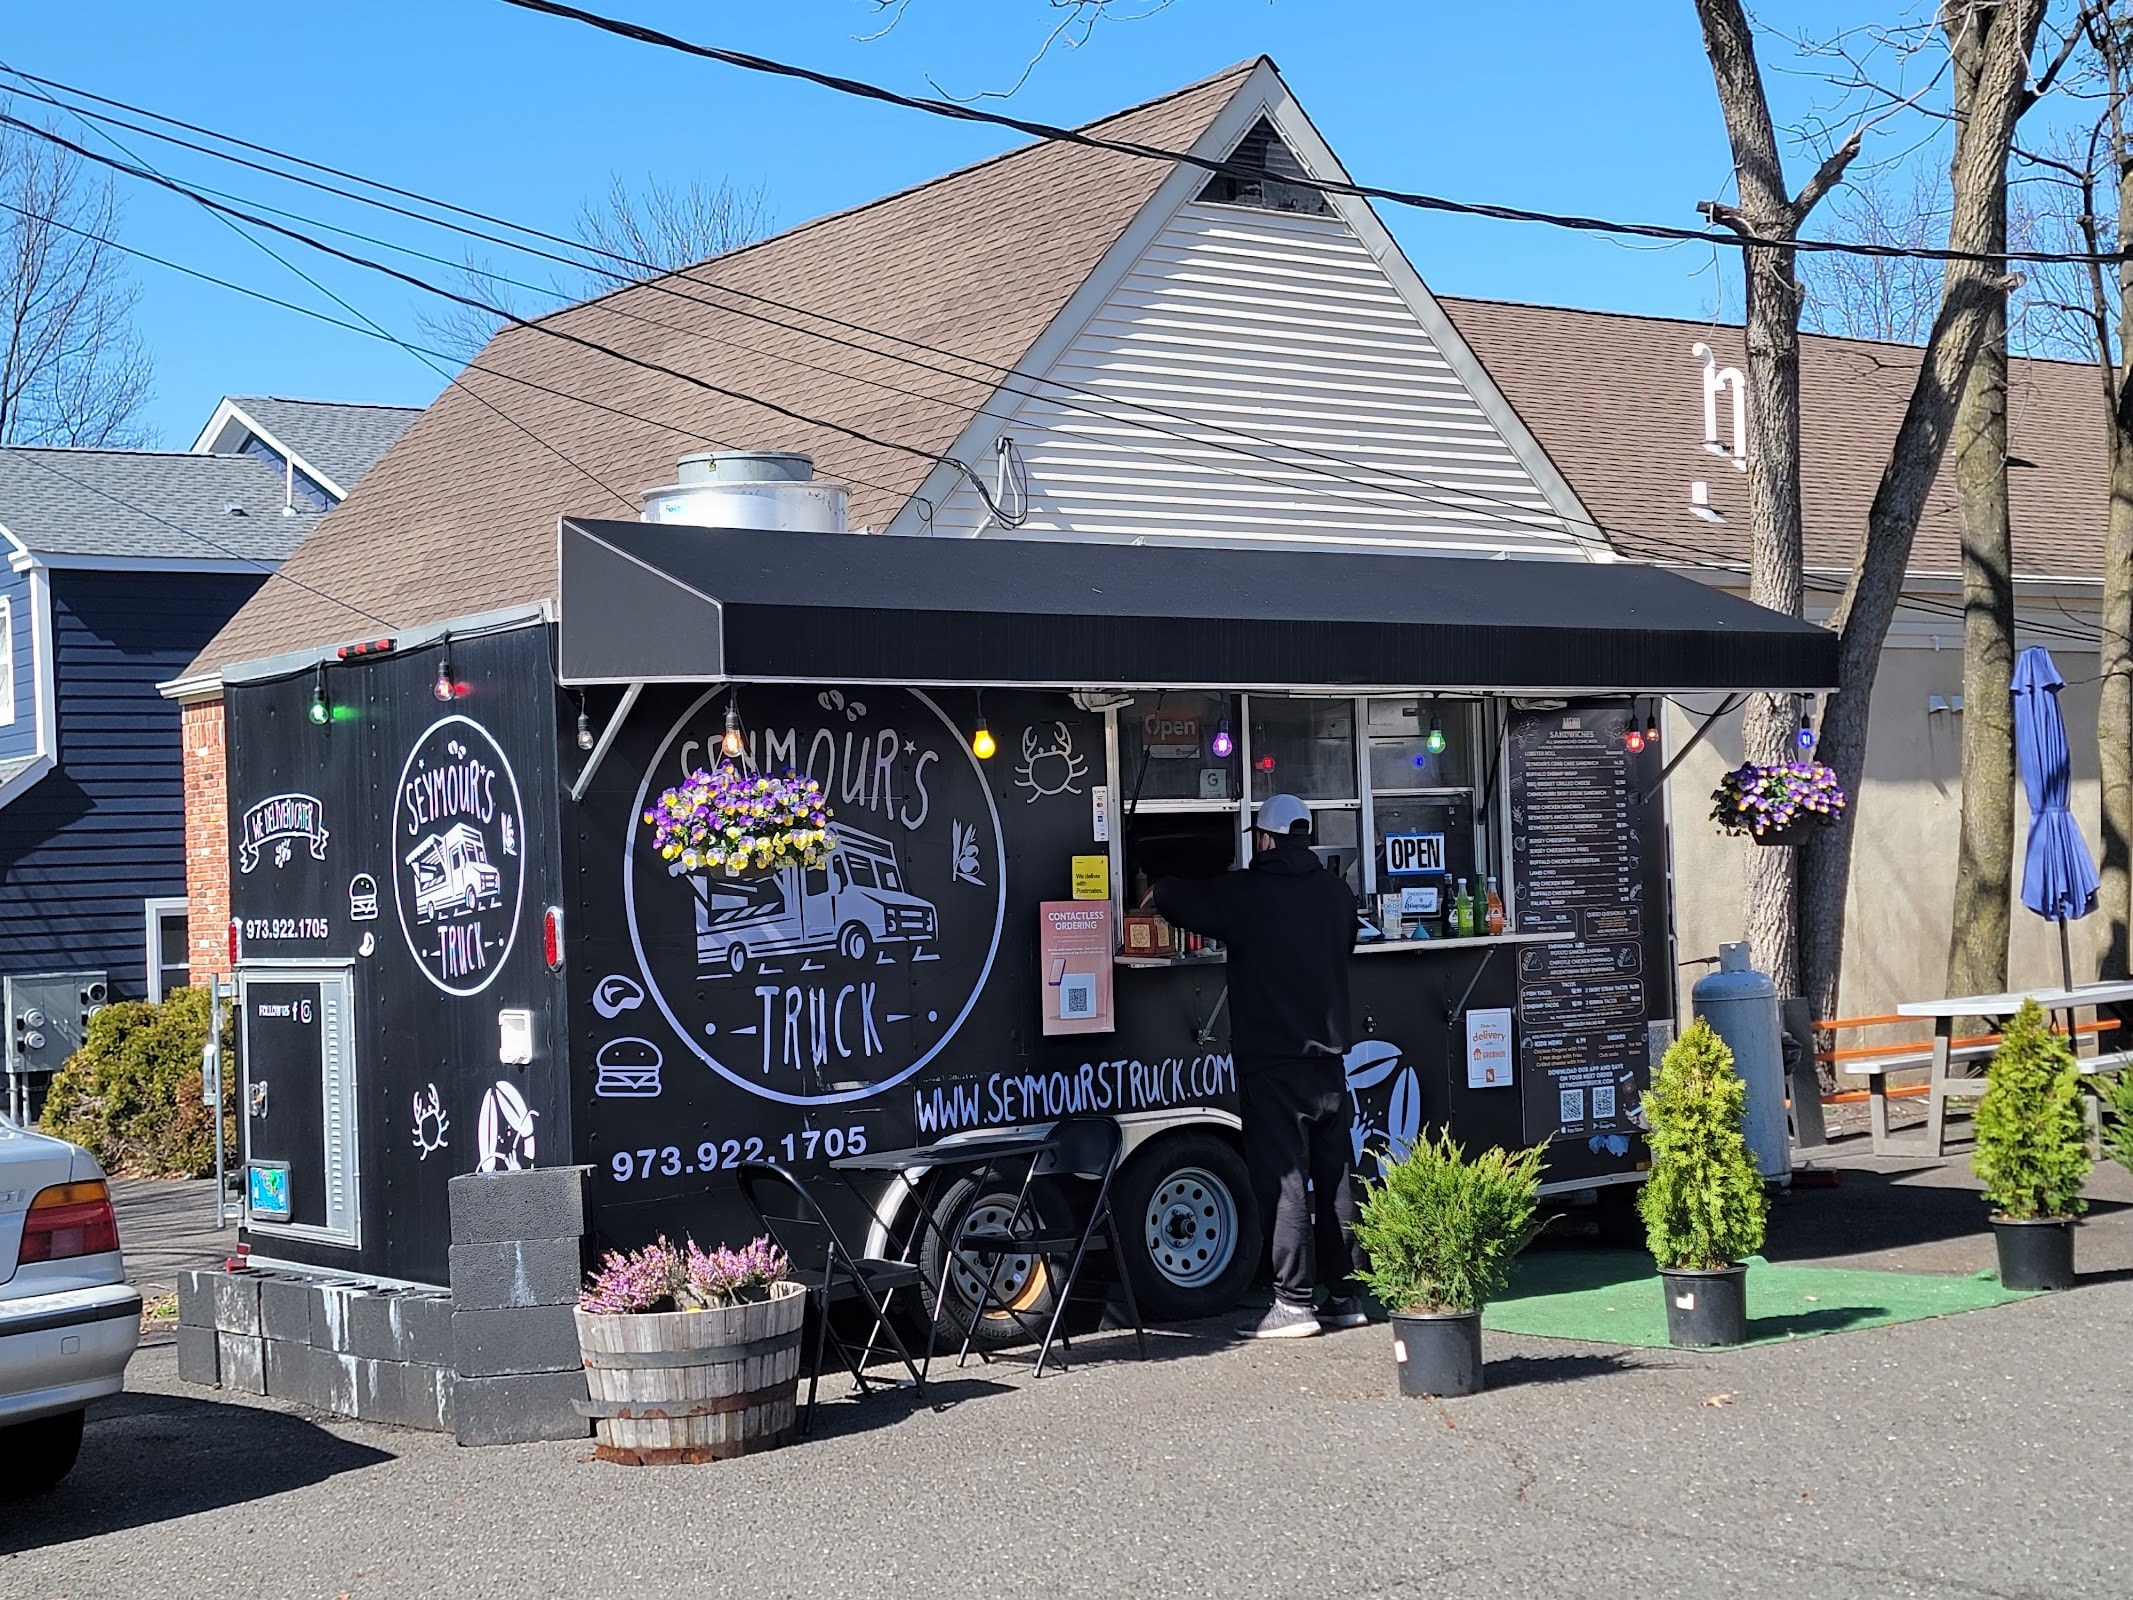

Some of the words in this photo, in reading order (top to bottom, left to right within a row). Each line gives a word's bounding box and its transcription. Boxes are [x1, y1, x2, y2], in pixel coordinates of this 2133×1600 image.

[1144, 714, 1196, 741] Open
[1549, 730, 1595, 739] SANDWICHES
[1392, 838, 1440, 870] OPEN
[1048, 911, 1104, 921] CONTACTLESS
[1055, 921, 1097, 930] ORDERING
[246, 918, 328, 940] 973.922.1705
[437, 924, 486, 980] TRUCK
[755, 981, 883, 1074] TRUCK
[1472, 1031, 1506, 1042] delivery
[1548, 1068, 1577, 1076] DOWNLOAD
[917, 1052, 1236, 1134] WWW.SEYMOURSTRUCK.COM
[611, 1125, 868, 1184] 973.922.1705
